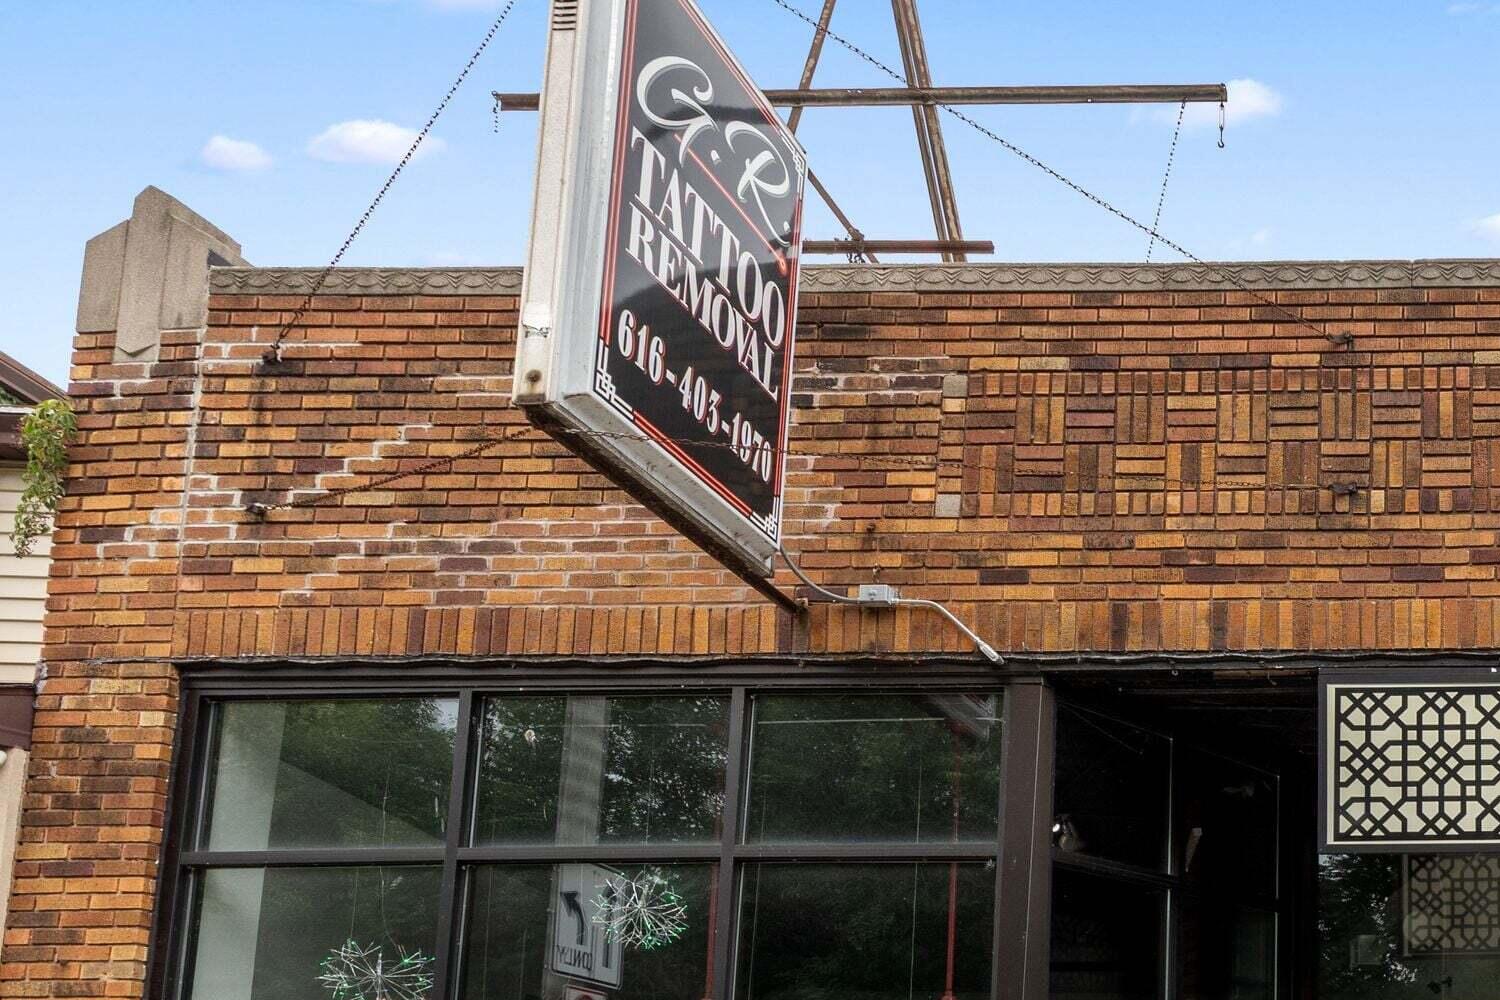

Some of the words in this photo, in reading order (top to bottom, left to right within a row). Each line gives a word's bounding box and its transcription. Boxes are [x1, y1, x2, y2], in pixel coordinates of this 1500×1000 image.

[625, 200, 779, 403] REMOVAL
[630, 126, 785, 347] TATTOO
[617, 309, 772, 483] 616-403-1970
